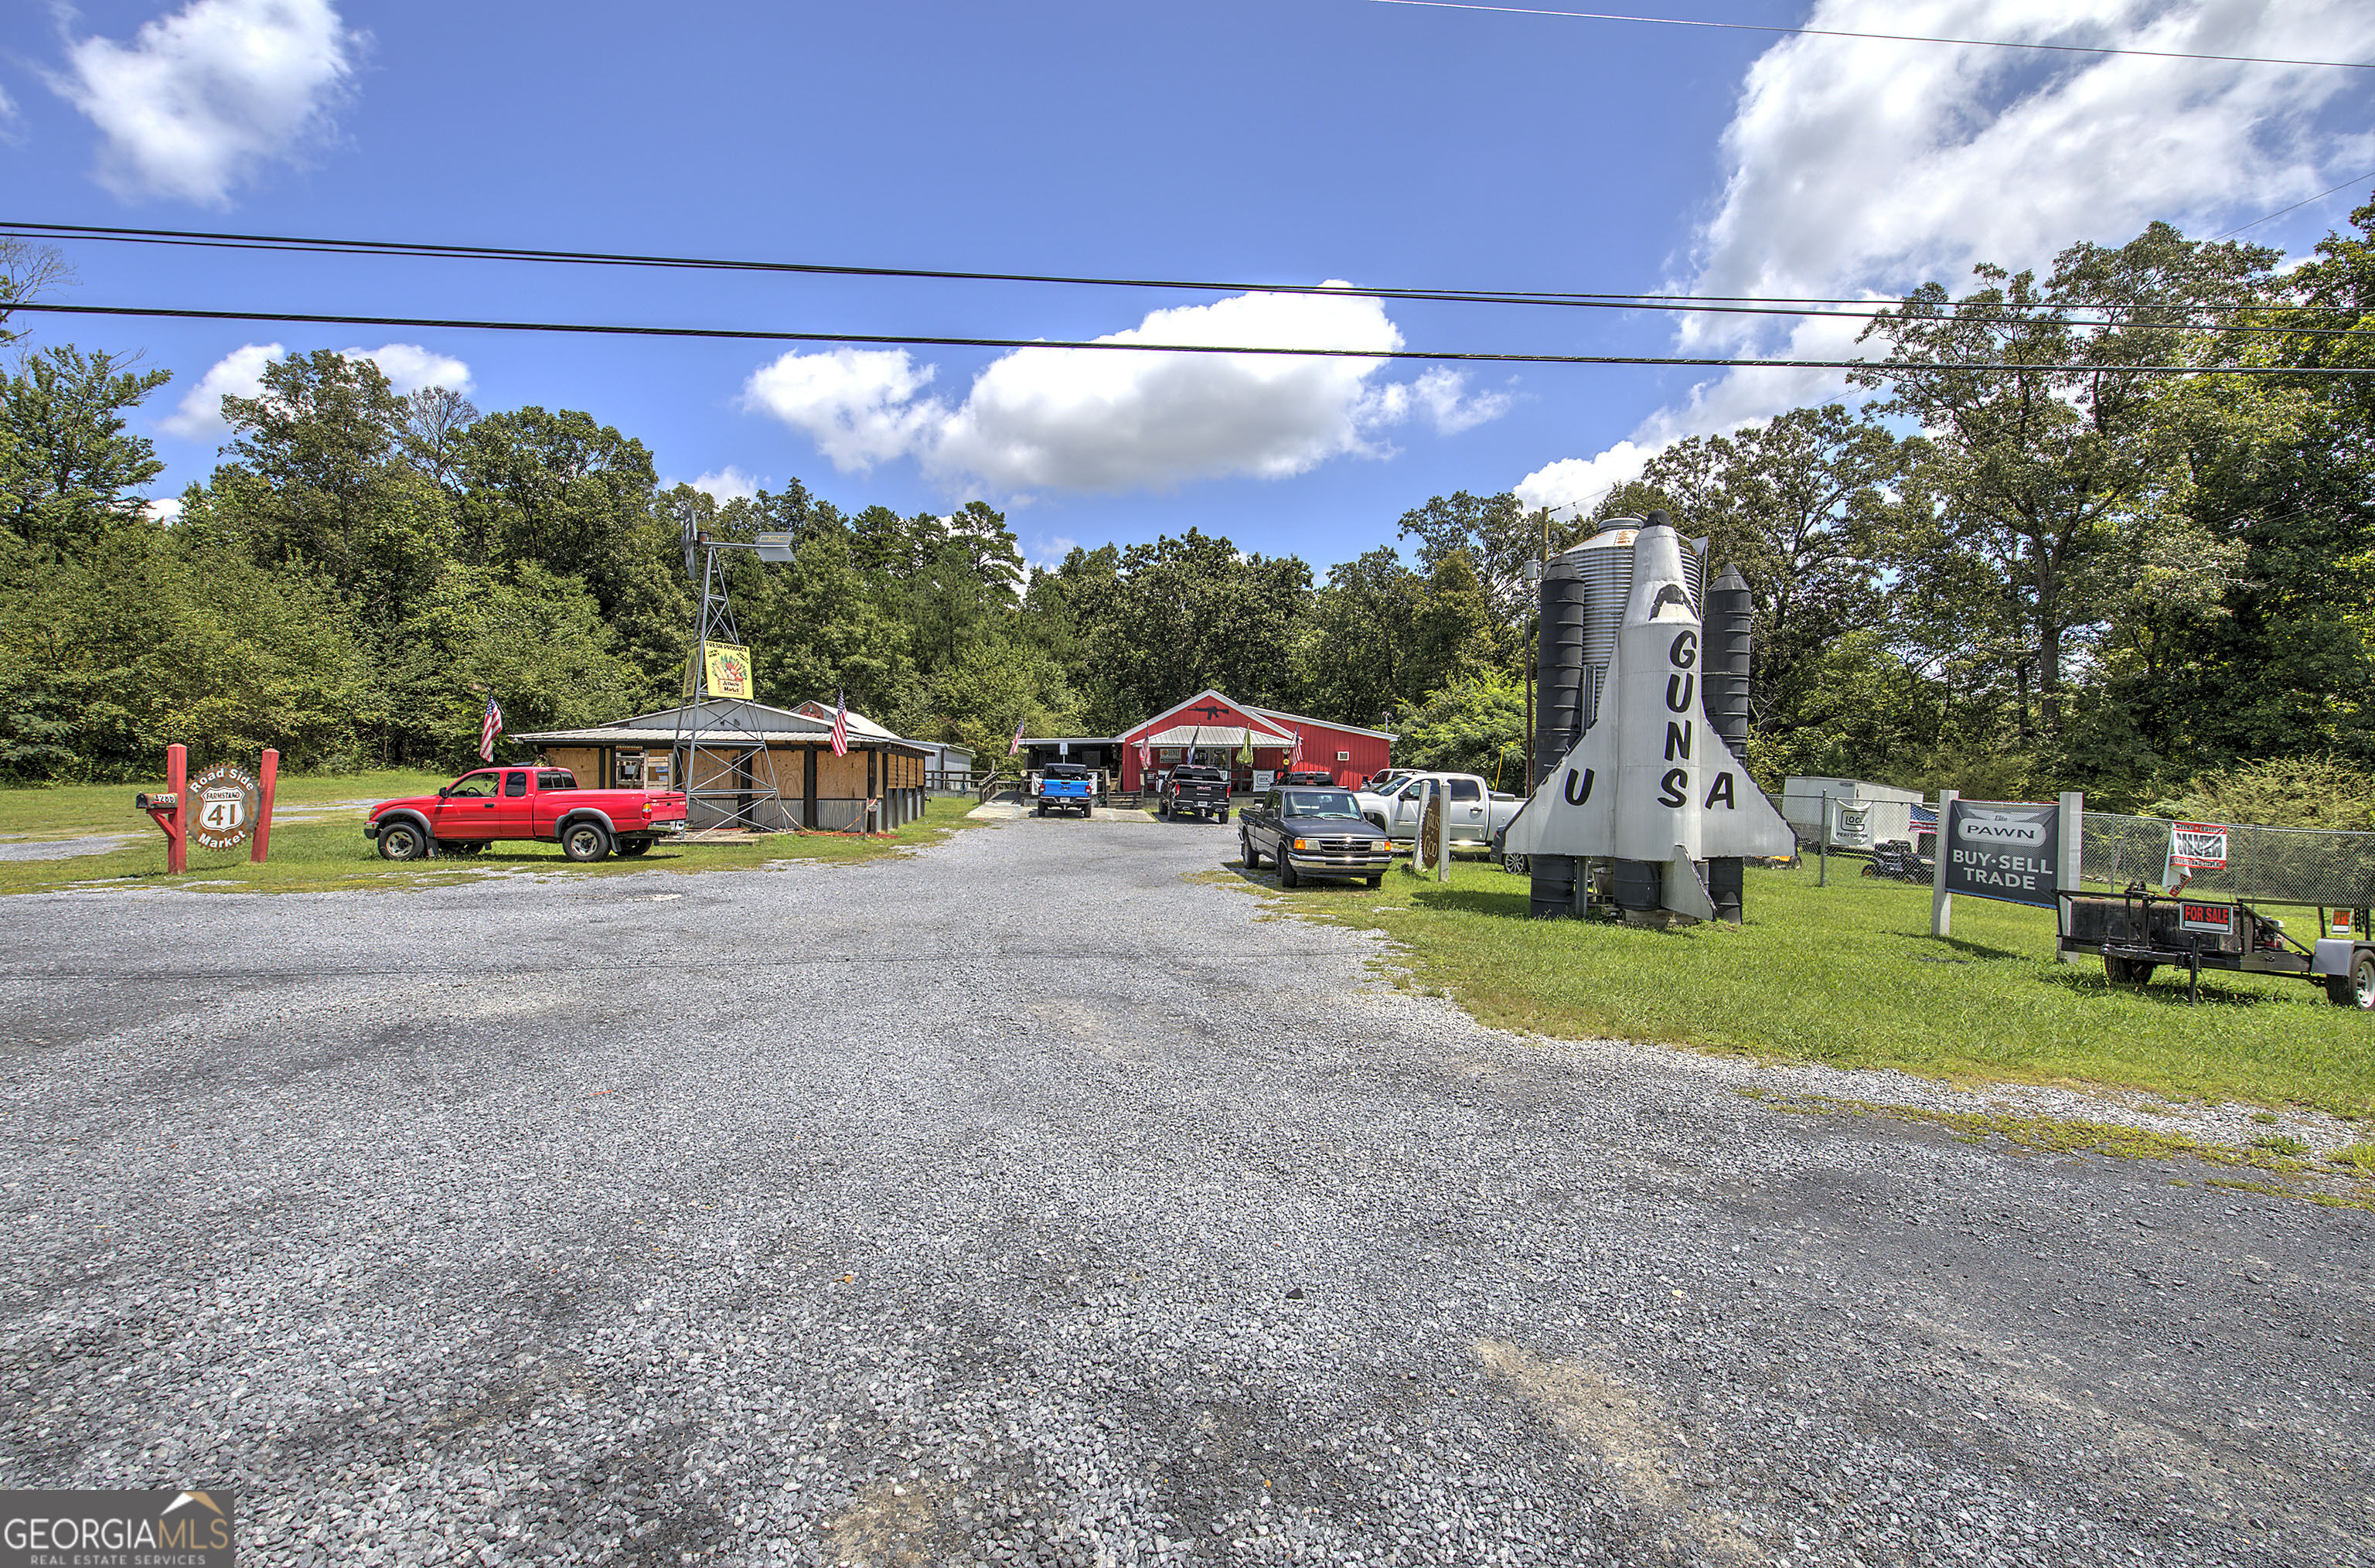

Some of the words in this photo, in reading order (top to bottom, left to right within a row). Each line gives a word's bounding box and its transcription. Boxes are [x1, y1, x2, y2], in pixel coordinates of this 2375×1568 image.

[724, 644, 748, 653] PRODUCE
[189, 768, 224, 793] Road
[229, 769, 254, 791] Side
[207, 804, 236, 826] 41
[198, 830, 246, 848] Market
[1967, 825, 2035, 839] PAWN
[1964, 868, 2036, 890] TRADE
[2185, 905, 2203, 922] FOR
[2206, 907, 2229, 924] SALE
